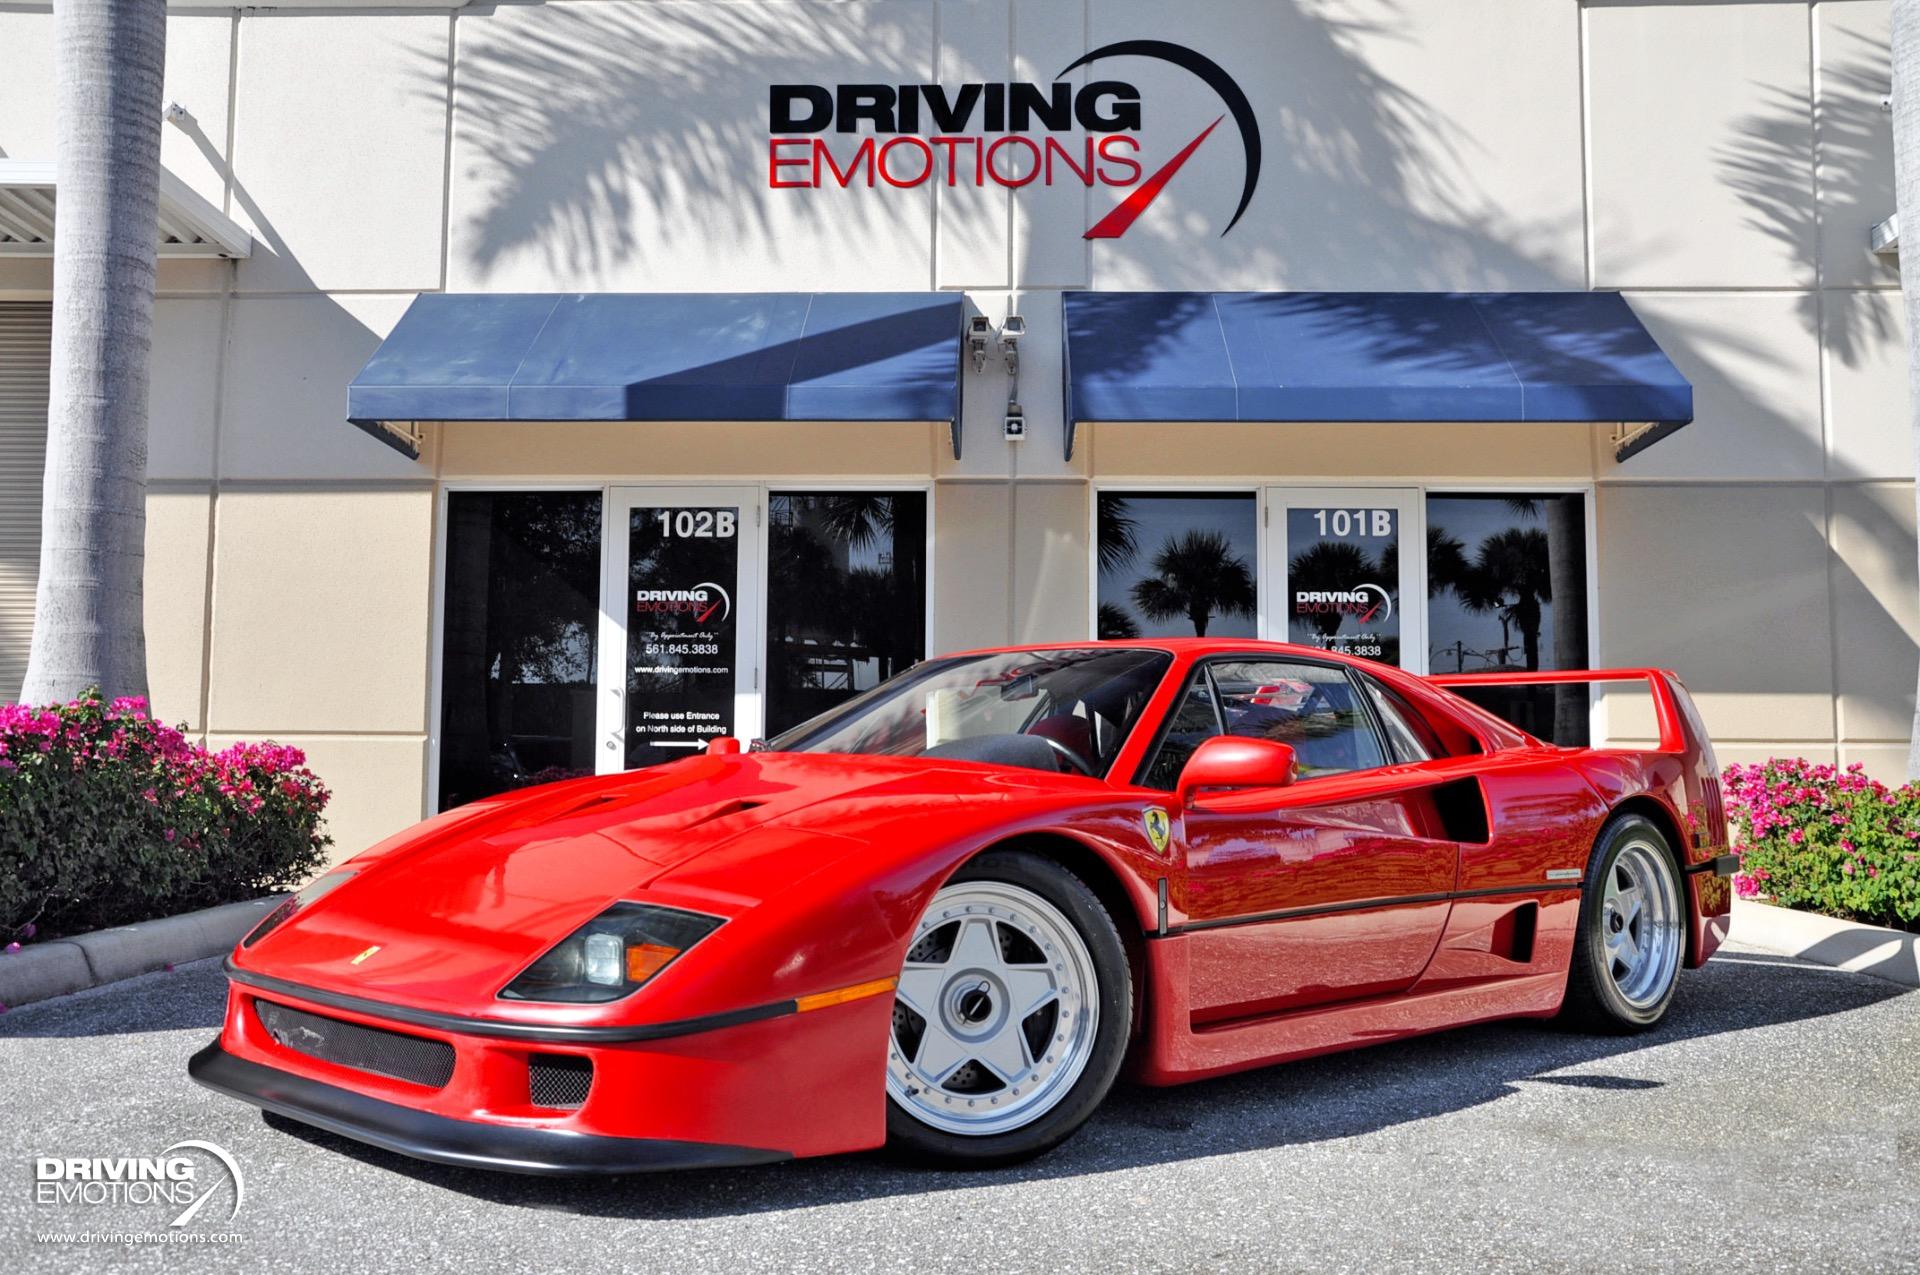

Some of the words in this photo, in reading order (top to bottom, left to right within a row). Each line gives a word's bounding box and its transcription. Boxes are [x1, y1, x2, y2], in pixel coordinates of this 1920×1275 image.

[770, 81, 1141, 134] DRIVING
[769, 136, 1142, 188] EMOTIONS
[657, 511, 736, 538] 102B
[1314, 510, 1391, 537] 101B
[636, 590, 708, 601] DRIVING
[1296, 591, 1369, 603] DRIVING
[636, 601, 708, 612] EMOTIONS
[1296, 603, 1369, 613] EMOTIONS
[645, 644, 718, 654] 561.845.3838
[634, 666, 729, 675] www.drivingemotions.com
[643, 711, 669, 720] Please
[670, 712, 685, 720] use
[686, 711, 720, 720] Entrance
[635, 725, 646, 733] on
[647, 724, 668, 733] North
[670, 724, 686, 733] side
[687, 724, 696, 733] of
[696, 724, 727, 735] Building
